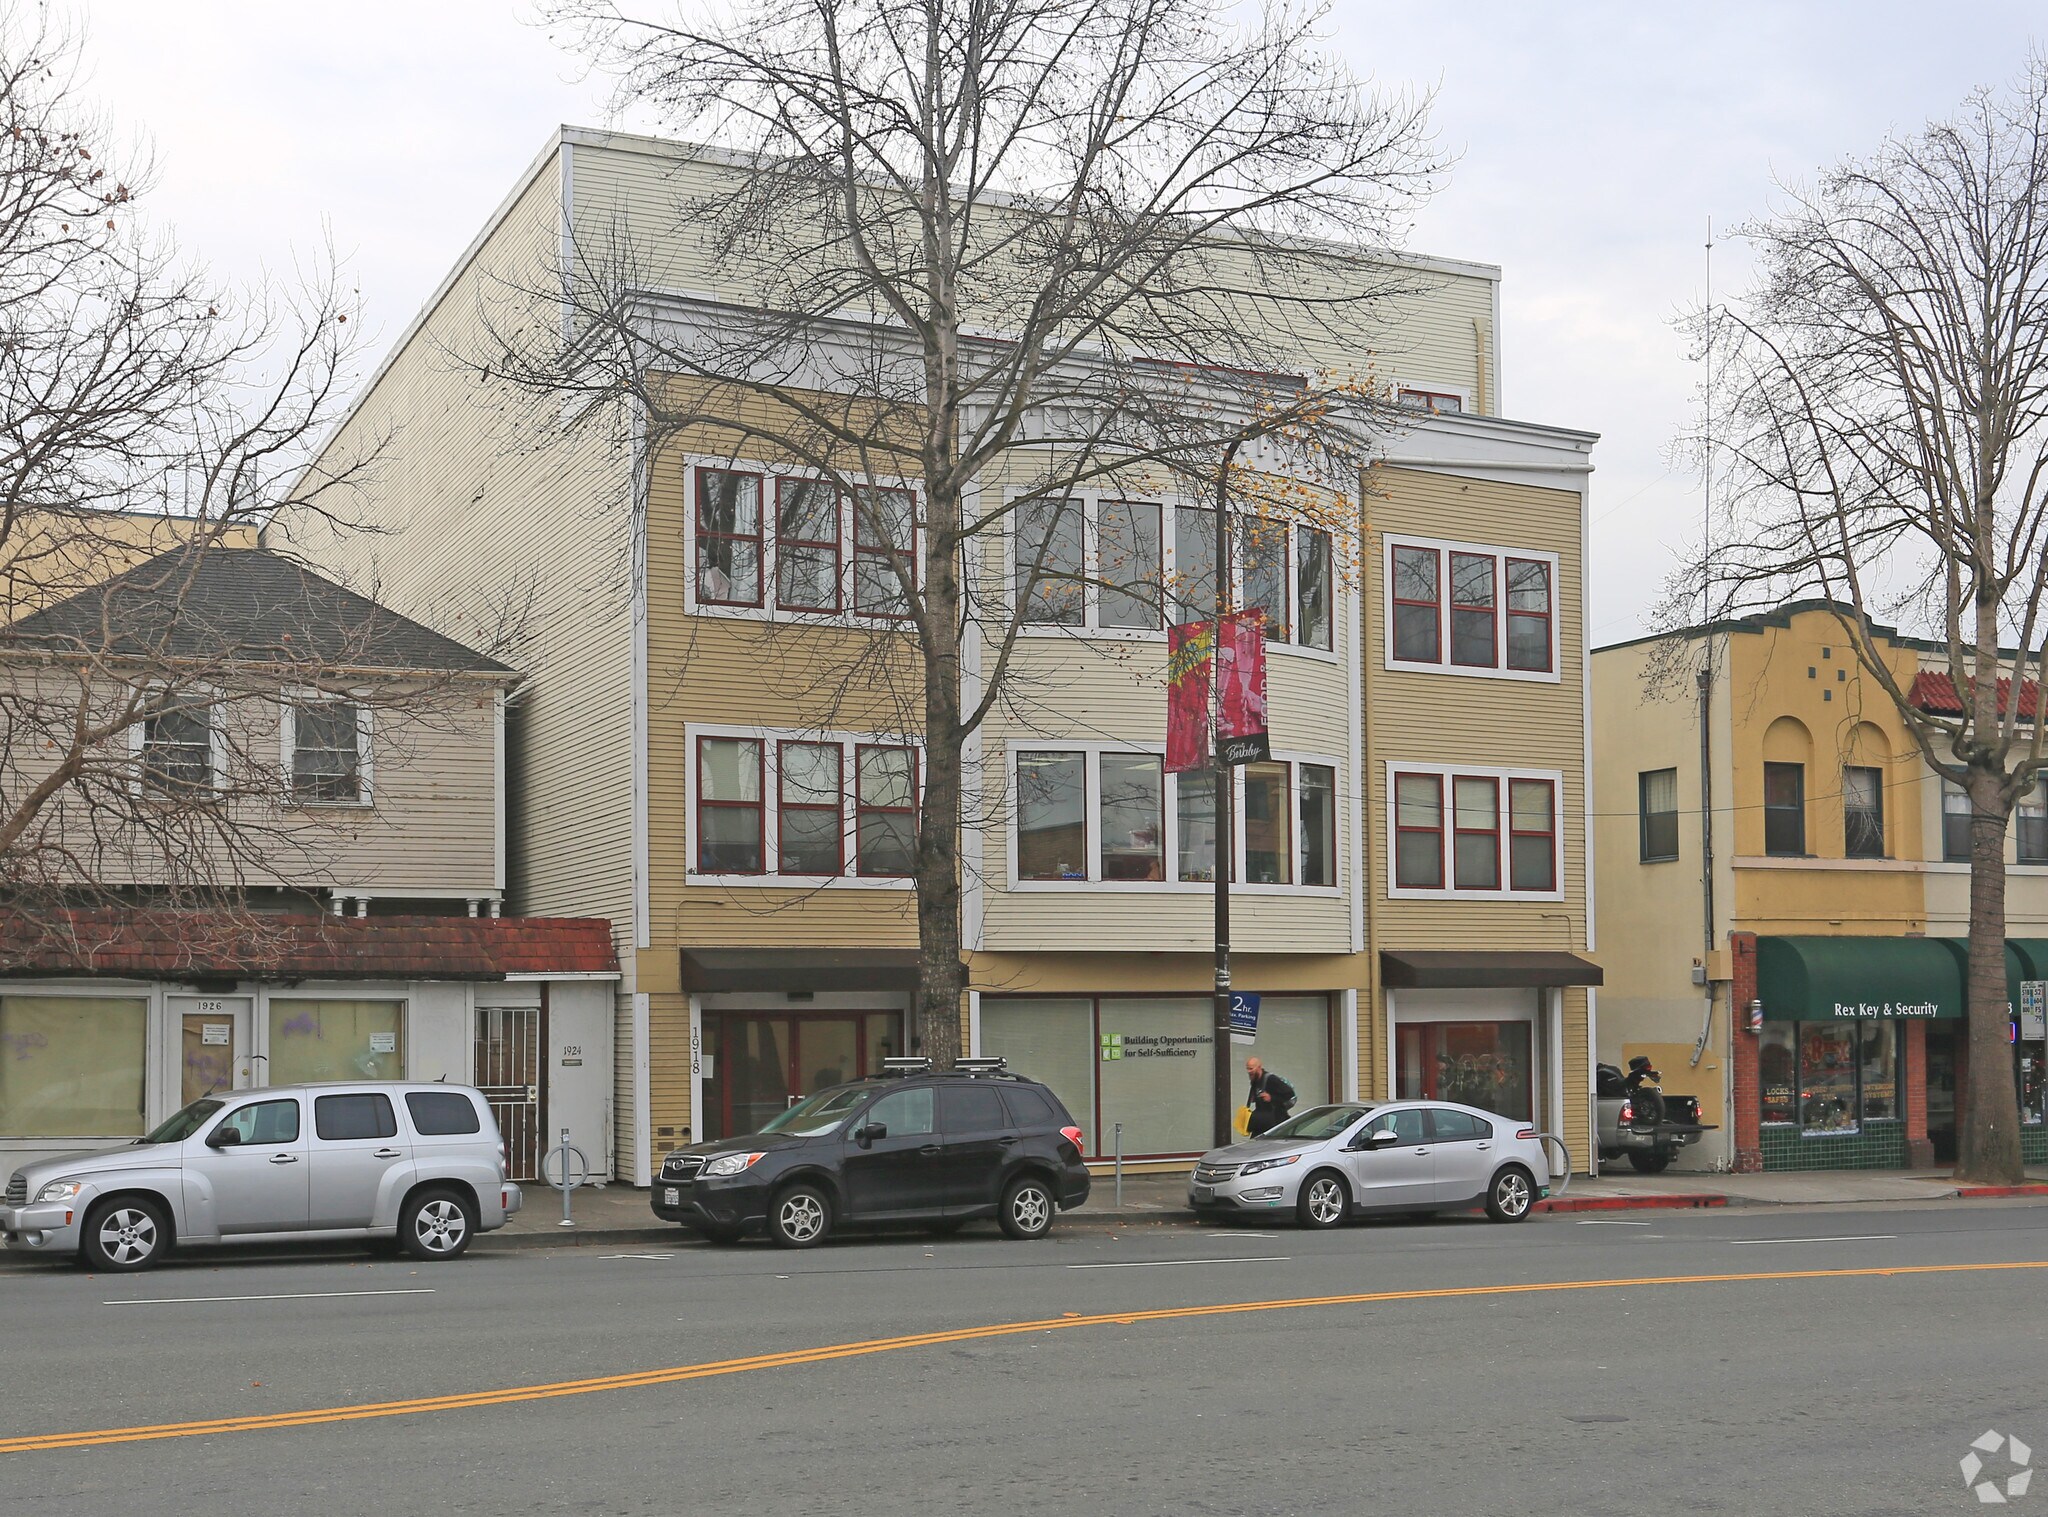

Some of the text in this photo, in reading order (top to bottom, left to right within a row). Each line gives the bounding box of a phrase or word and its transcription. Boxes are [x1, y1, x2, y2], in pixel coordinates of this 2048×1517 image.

[198, 1001, 221, 1010] 1926
[1834, 1002, 1938, 1018] Rex Key & Security
[1124, 1035, 1214, 1046] Building Opportunities
[563, 1046, 582, 1055] 1924
[692, 1027, 700, 1074] 1918
[1124, 1048, 1198, 1058] for Self-Sufficiency
